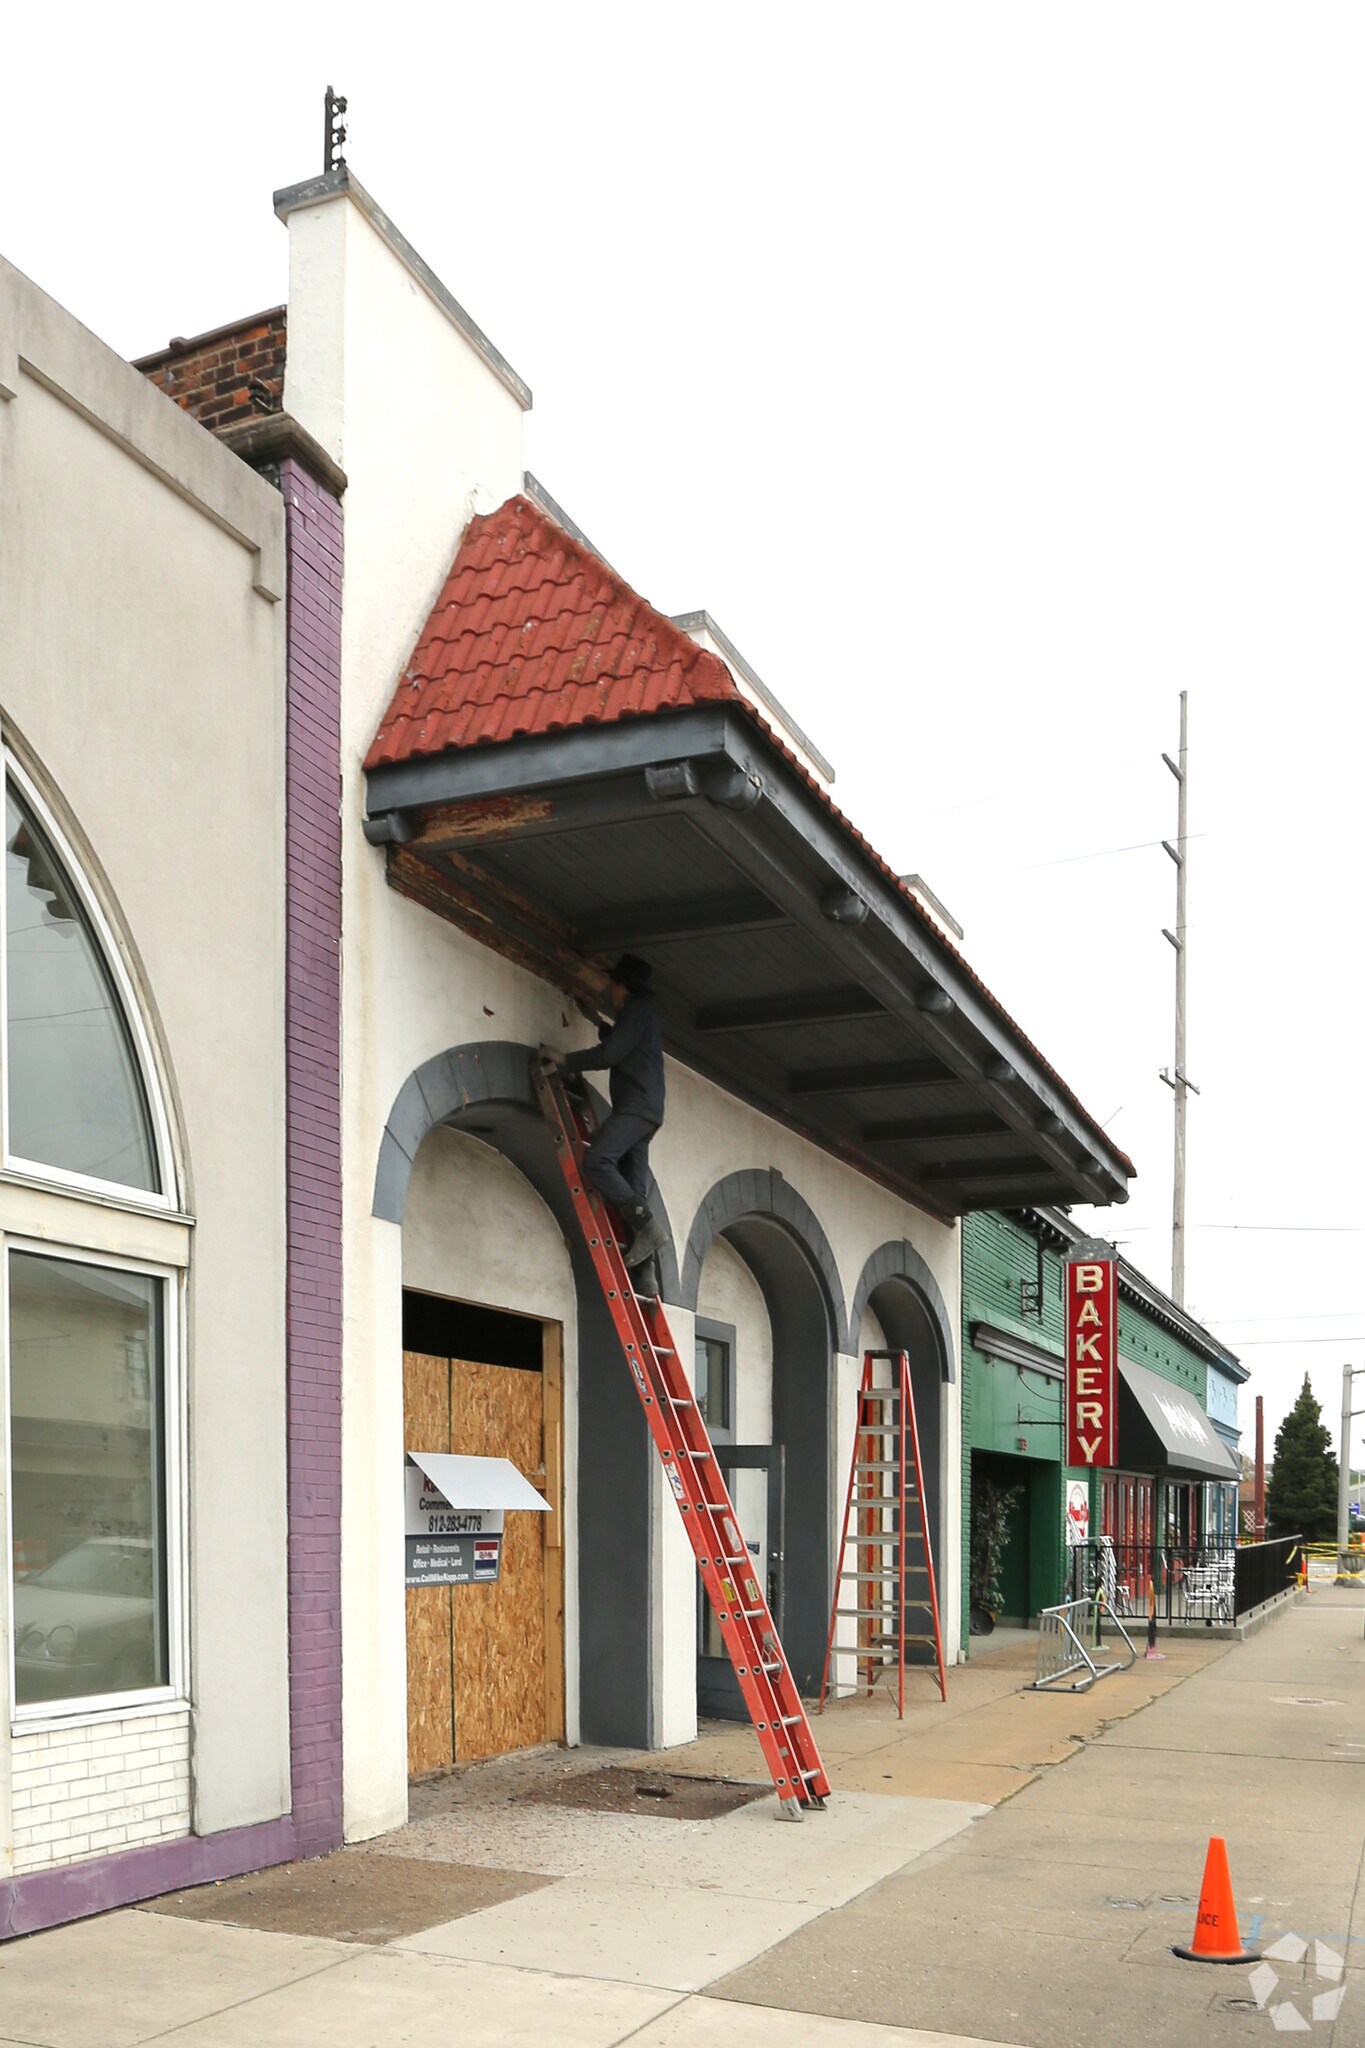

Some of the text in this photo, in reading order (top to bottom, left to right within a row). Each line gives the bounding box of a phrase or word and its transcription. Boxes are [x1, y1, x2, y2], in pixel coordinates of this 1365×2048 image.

[1076, 1265, 1104, 1463] BAKERY
[428, 1515, 482, 1532] 812-283-4778
[412, 1556, 463, 1569] Office Medical Land
[1197, 1913, 1219, 1927] LICE
